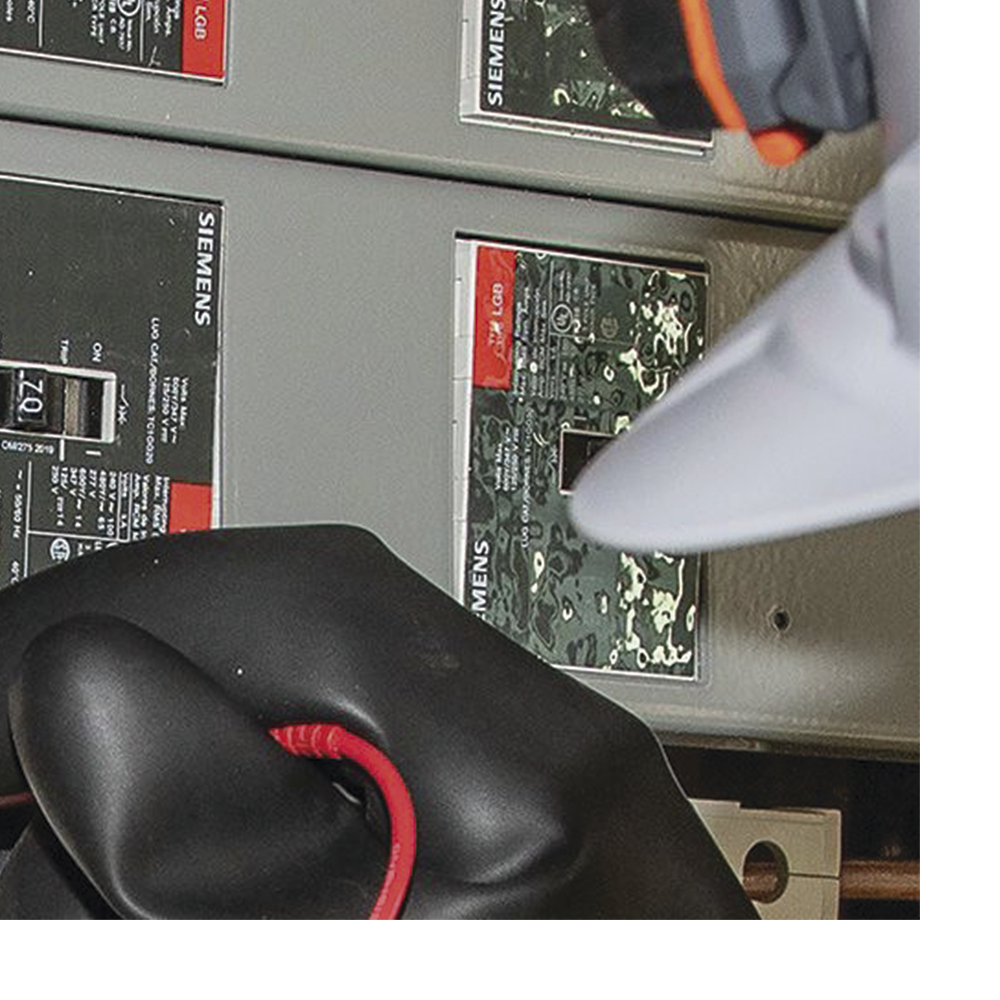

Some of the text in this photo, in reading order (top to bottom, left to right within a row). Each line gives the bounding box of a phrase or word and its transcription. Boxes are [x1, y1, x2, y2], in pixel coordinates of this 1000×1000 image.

[194, 4, 208, 41] LGB
[195, 212, 215, 327] SIEMENS
[491, 282, 504, 317] LGB
[91, 342, 103, 363] ON
[20, 377, 44, 414] 70
[470, 539, 489, 622] MENS
